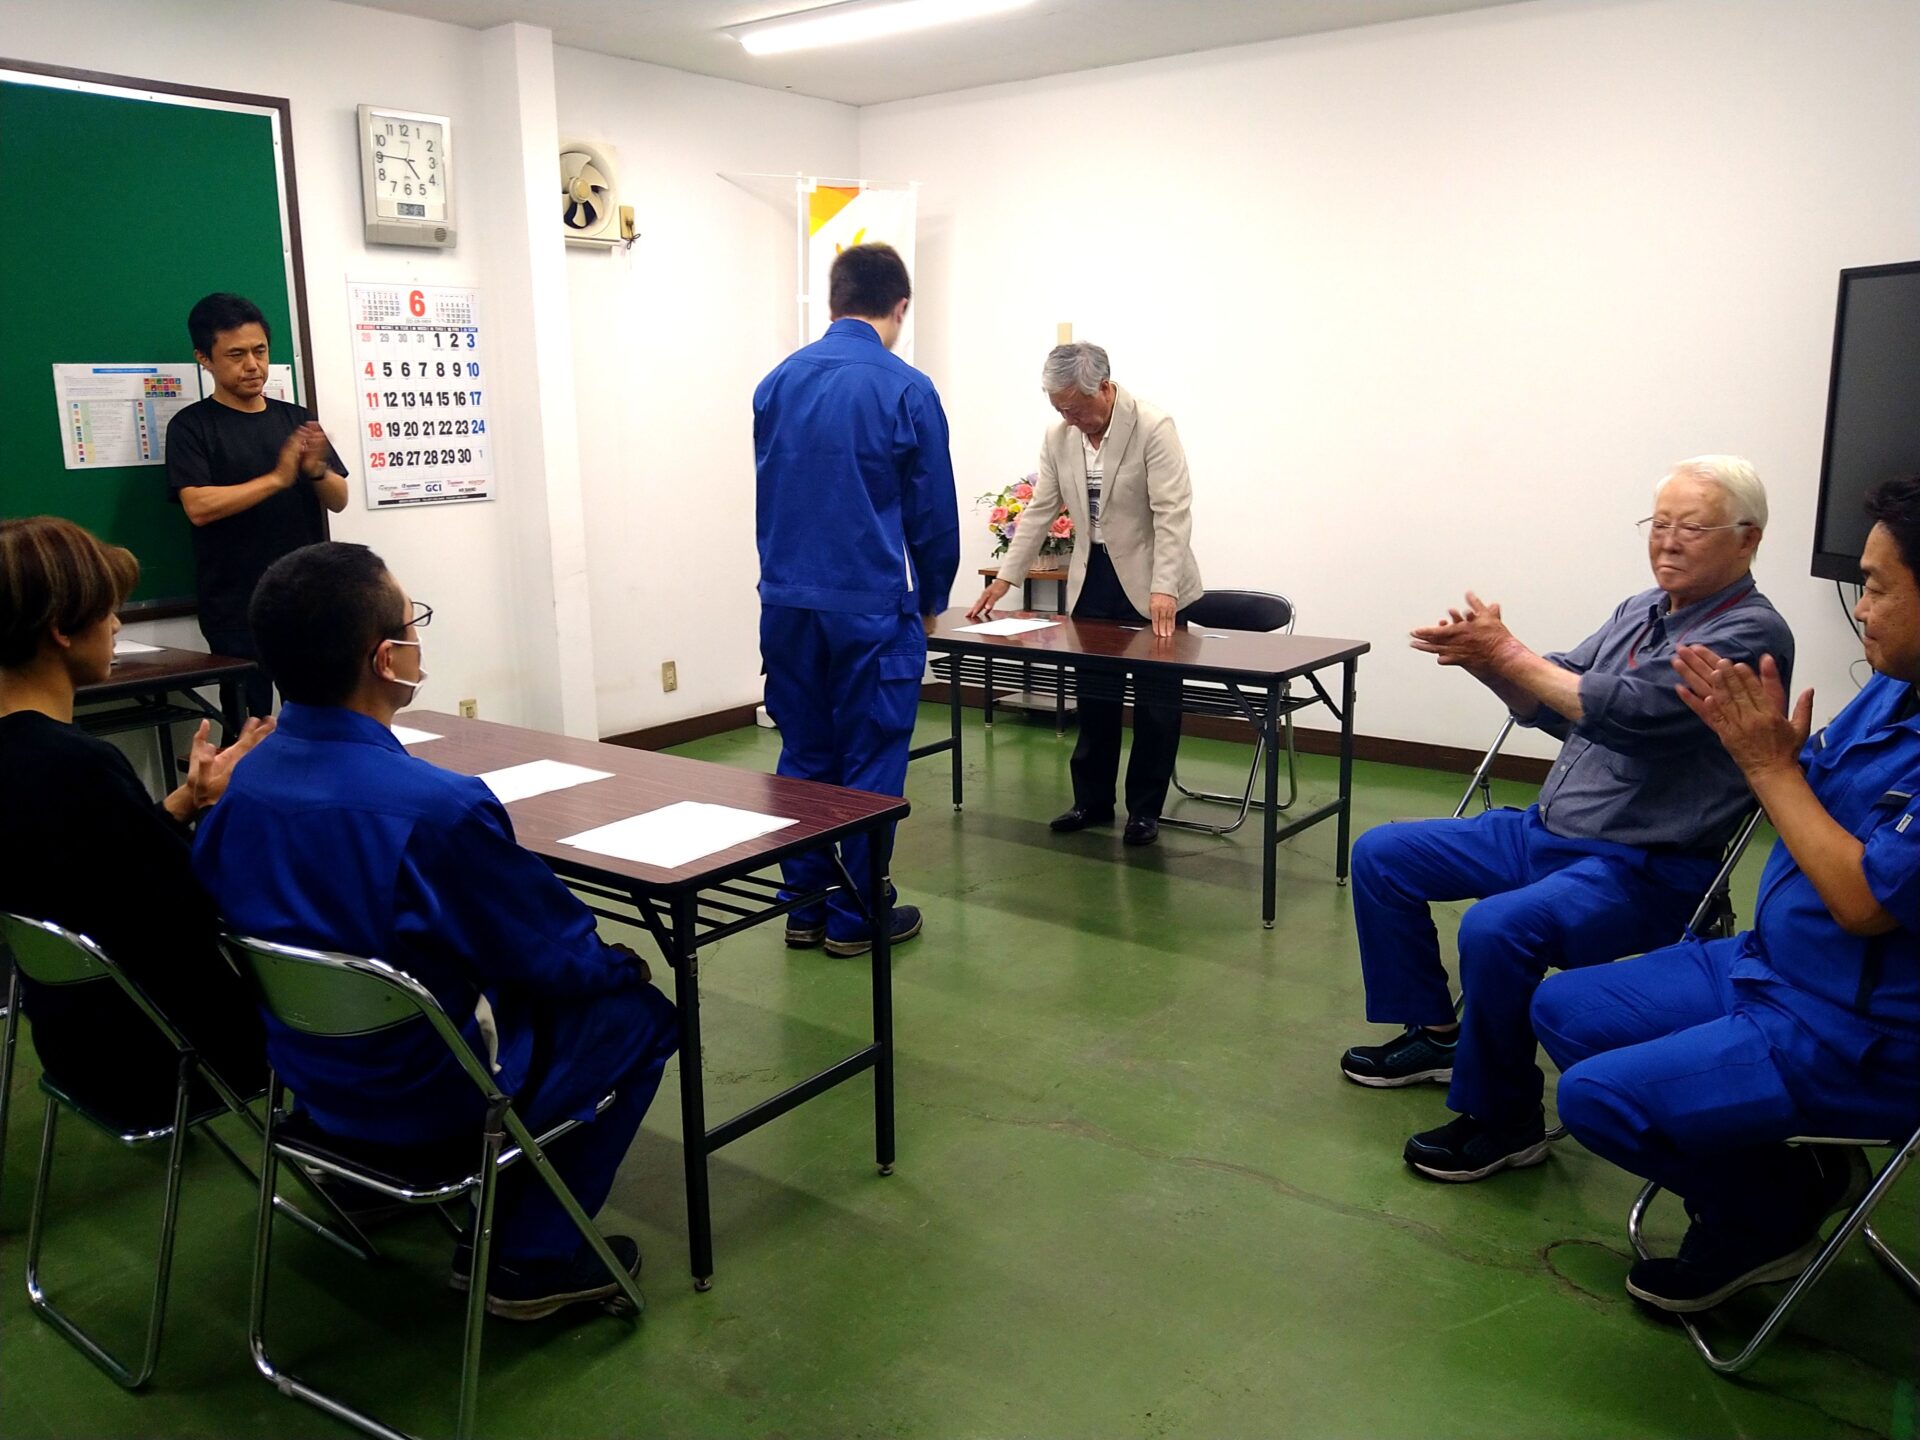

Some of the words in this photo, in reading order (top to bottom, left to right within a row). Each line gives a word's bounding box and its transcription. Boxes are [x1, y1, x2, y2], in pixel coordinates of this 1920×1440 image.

[385, 124, 393, 136] 11
[399, 124, 409, 137] 12
[416, 127, 420, 139] 1
[375, 134, 386, 147] 10
[426, 140, 433, 152] 2
[376, 151, 384, 163] 9
[429, 157, 436, 169] 3
[378, 168, 386, 181] 8
[428, 174, 436, 186] 4
[390, 180, 397, 193] 7
[404, 183, 412, 196] 6
[419, 183, 426, 195] 5
[409, 290, 426, 317] 6
[380, 333, 389, 342] 29
[398, 333, 407, 343] 30
[417, 334, 424, 343] 31
[434, 333, 441, 347] 1
[450, 333, 459, 347] 2
[467, 334, 475, 348] 3
[365, 362, 374, 377] 4
[383, 362, 392, 377] 5
[401, 362, 410, 377] 6
[418, 362, 427, 377] 7
[436, 362, 445, 377] 8
[452, 362, 461, 377] 9
[467, 362, 479, 377] 10
[367, 393, 379, 407] 11
[384, 392, 398, 407] 12
[402, 392, 415, 406] 13
[419, 392, 432, 406] 14
[436, 392, 449, 406] 15
[453, 392, 466, 406] 16
[470, 391, 481, 405] 17
[368, 423, 382, 437] 18
[386, 422, 400, 437] 19
[404, 422, 418, 436] 20
[422, 421, 434, 435] 21
[439, 421, 452, 435] 22
[455, 420, 468, 434] 23
[471, 420, 485, 434] 24
[370, 453, 385, 467] 25
[389, 452, 403, 466] 26
[406, 451, 420, 465] 27
[424, 450, 438, 465] 28
[441, 449, 454, 464] 29
[458, 448, 471, 462] 30
[479, 449, 483, 457] 1
[425, 484, 442, 492] GCI
